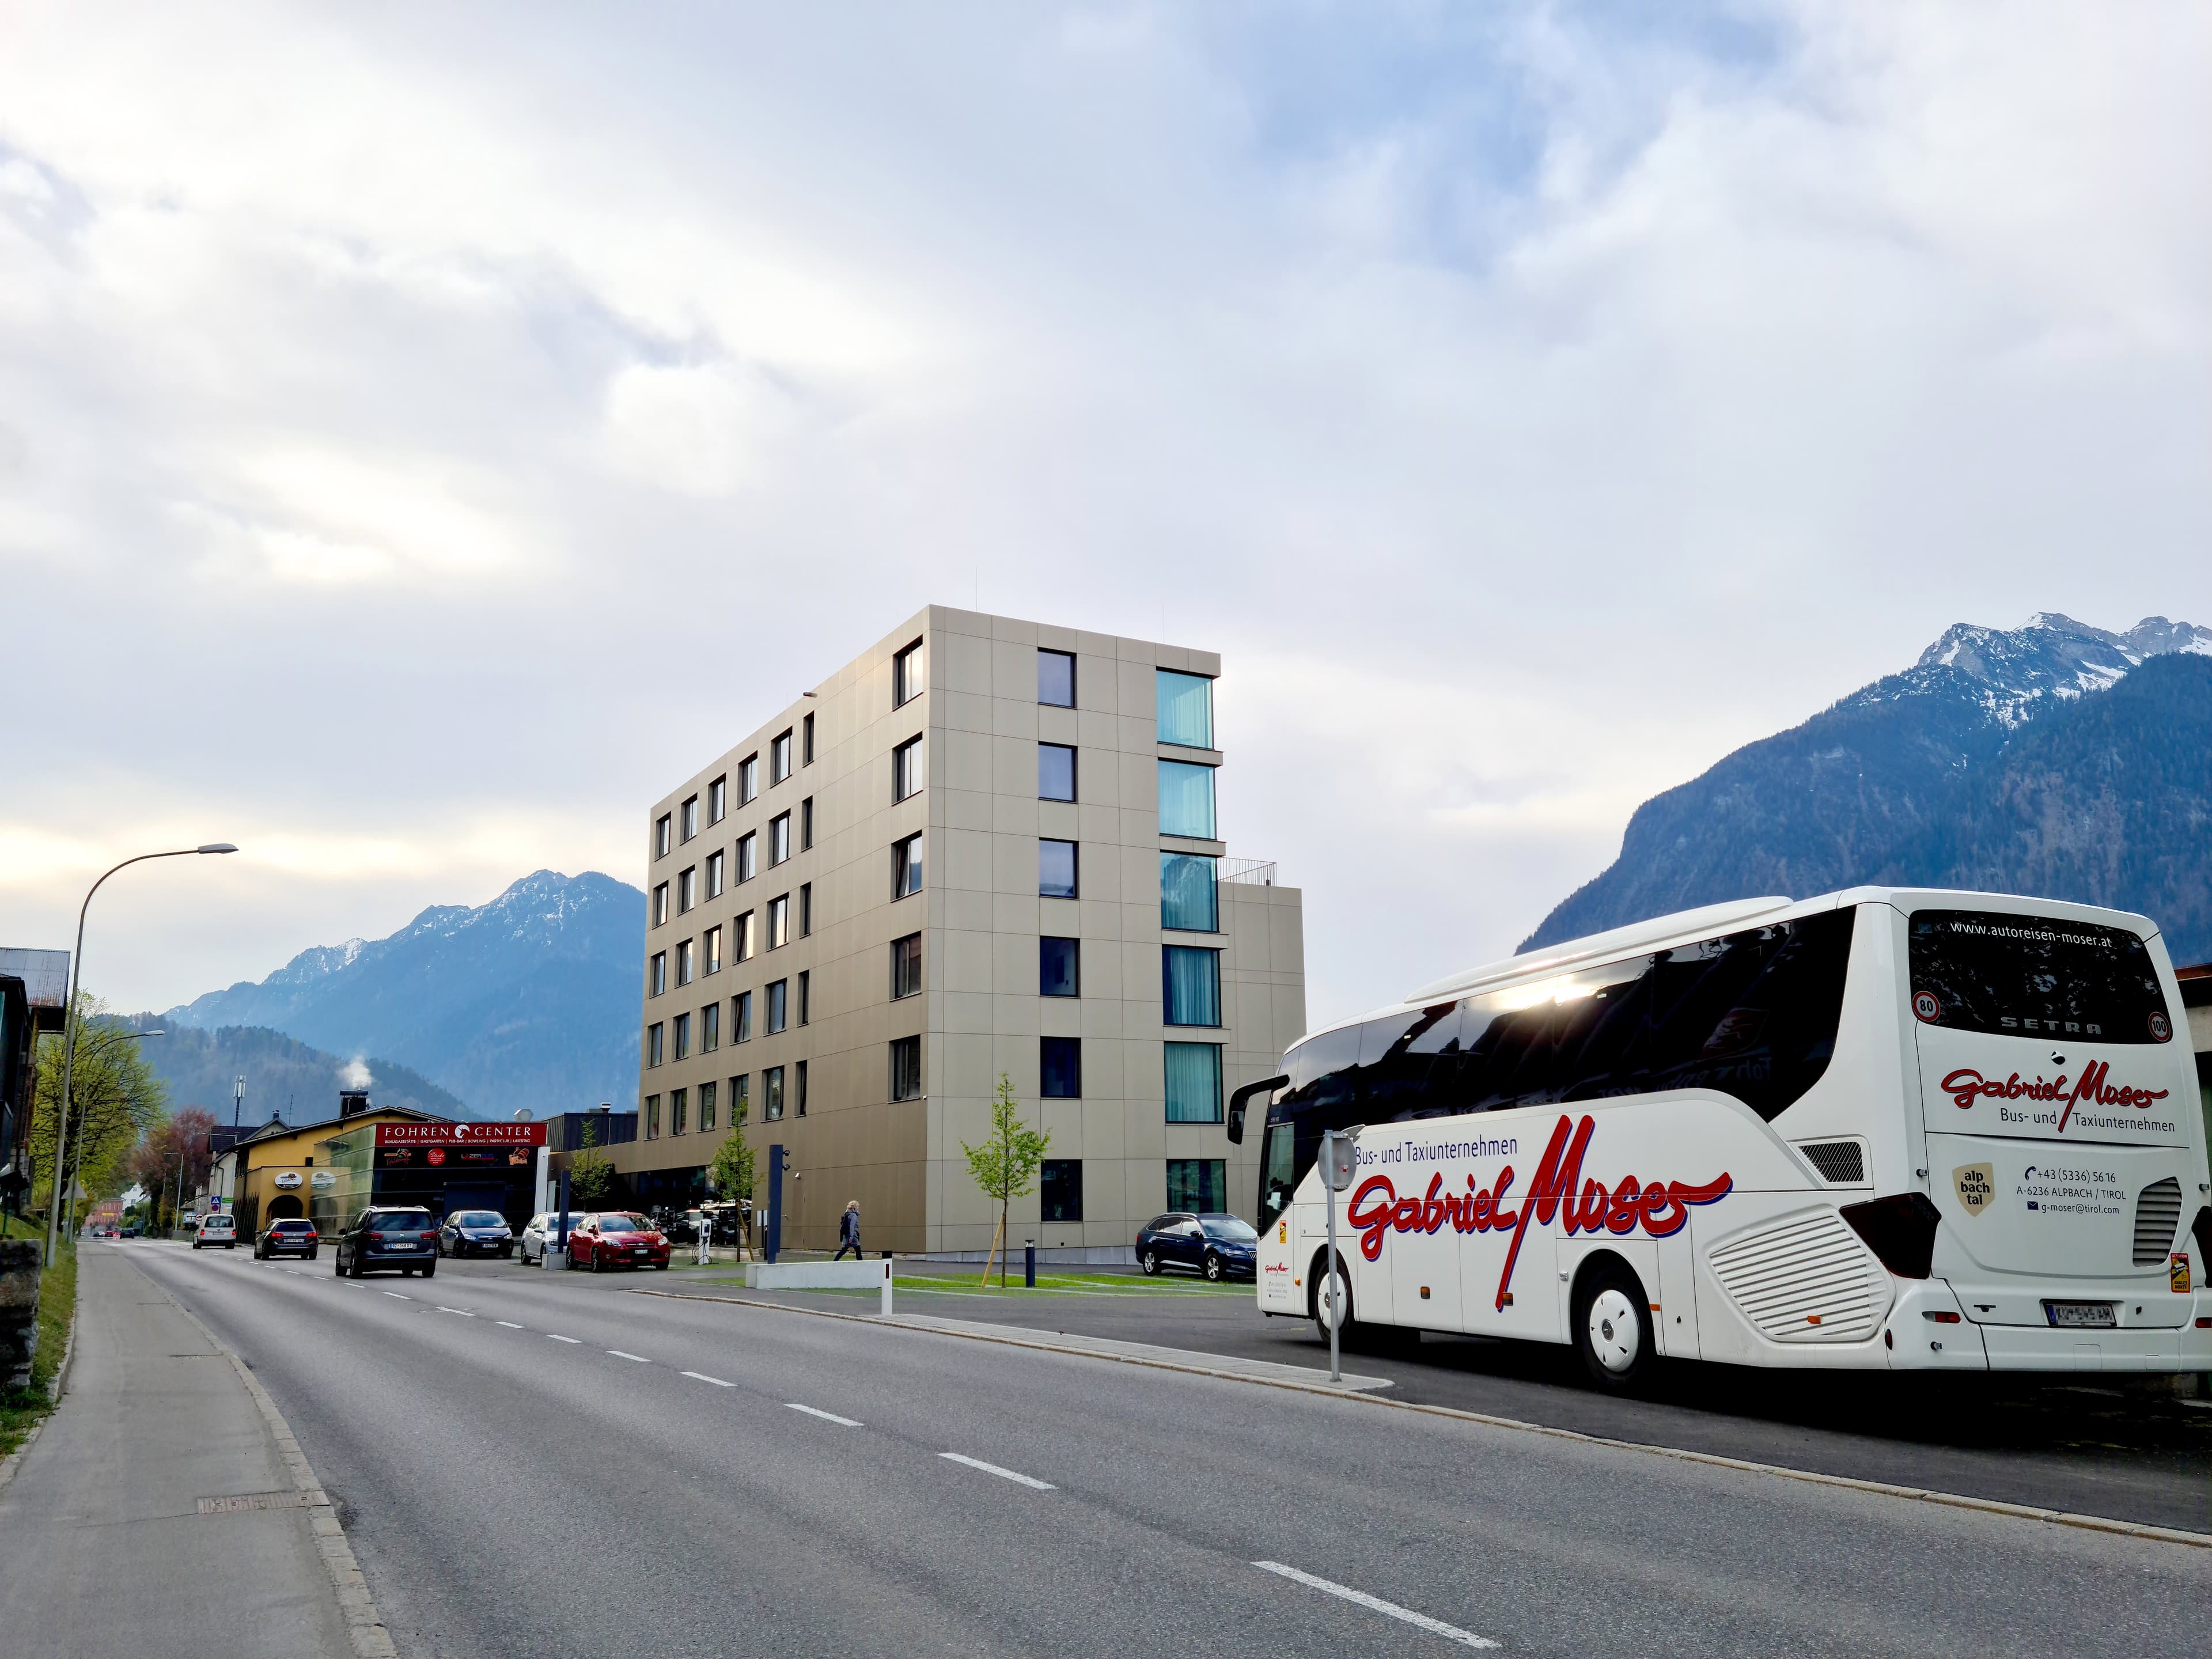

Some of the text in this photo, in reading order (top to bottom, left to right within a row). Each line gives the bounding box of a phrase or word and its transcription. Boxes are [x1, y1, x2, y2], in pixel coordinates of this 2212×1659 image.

[1950, 922, 2112, 948] www.autoreisen-moser.at
[1920, 999, 1933, 1012] 80
[2001, 1017, 2101, 1034] SETRA
[2152, 1020, 2166, 1032] 100
[1941, 1059, 2169, 1133] Gabriel Moser
[2001, 1108, 2175, 1132] Bus- und Taxiunternehmen
[385, 1127, 531, 1136] FOHREN CENTER
[1355, 1134, 1517, 1165] Bus- und Taxiunternehmen
[1964, 1170, 1983, 1183] alp
[2037, 1169, 2056, 1179] +43
[2058, 1168, 2090, 1184] (5336)
[1960, 1181, 1990, 1193] bach
[2017, 1185, 2049, 1196] A-6236
[2051, 1188, 2092, 1198] ALPBACH
[2101, 1190, 2127, 1200] TIROL
[1966, 1194, 1983, 1205] tal
[1347, 1114, 1733, 1313] Gabriel Moser
[2041, 1203, 2119, 1214] g-moser@tirol.com
